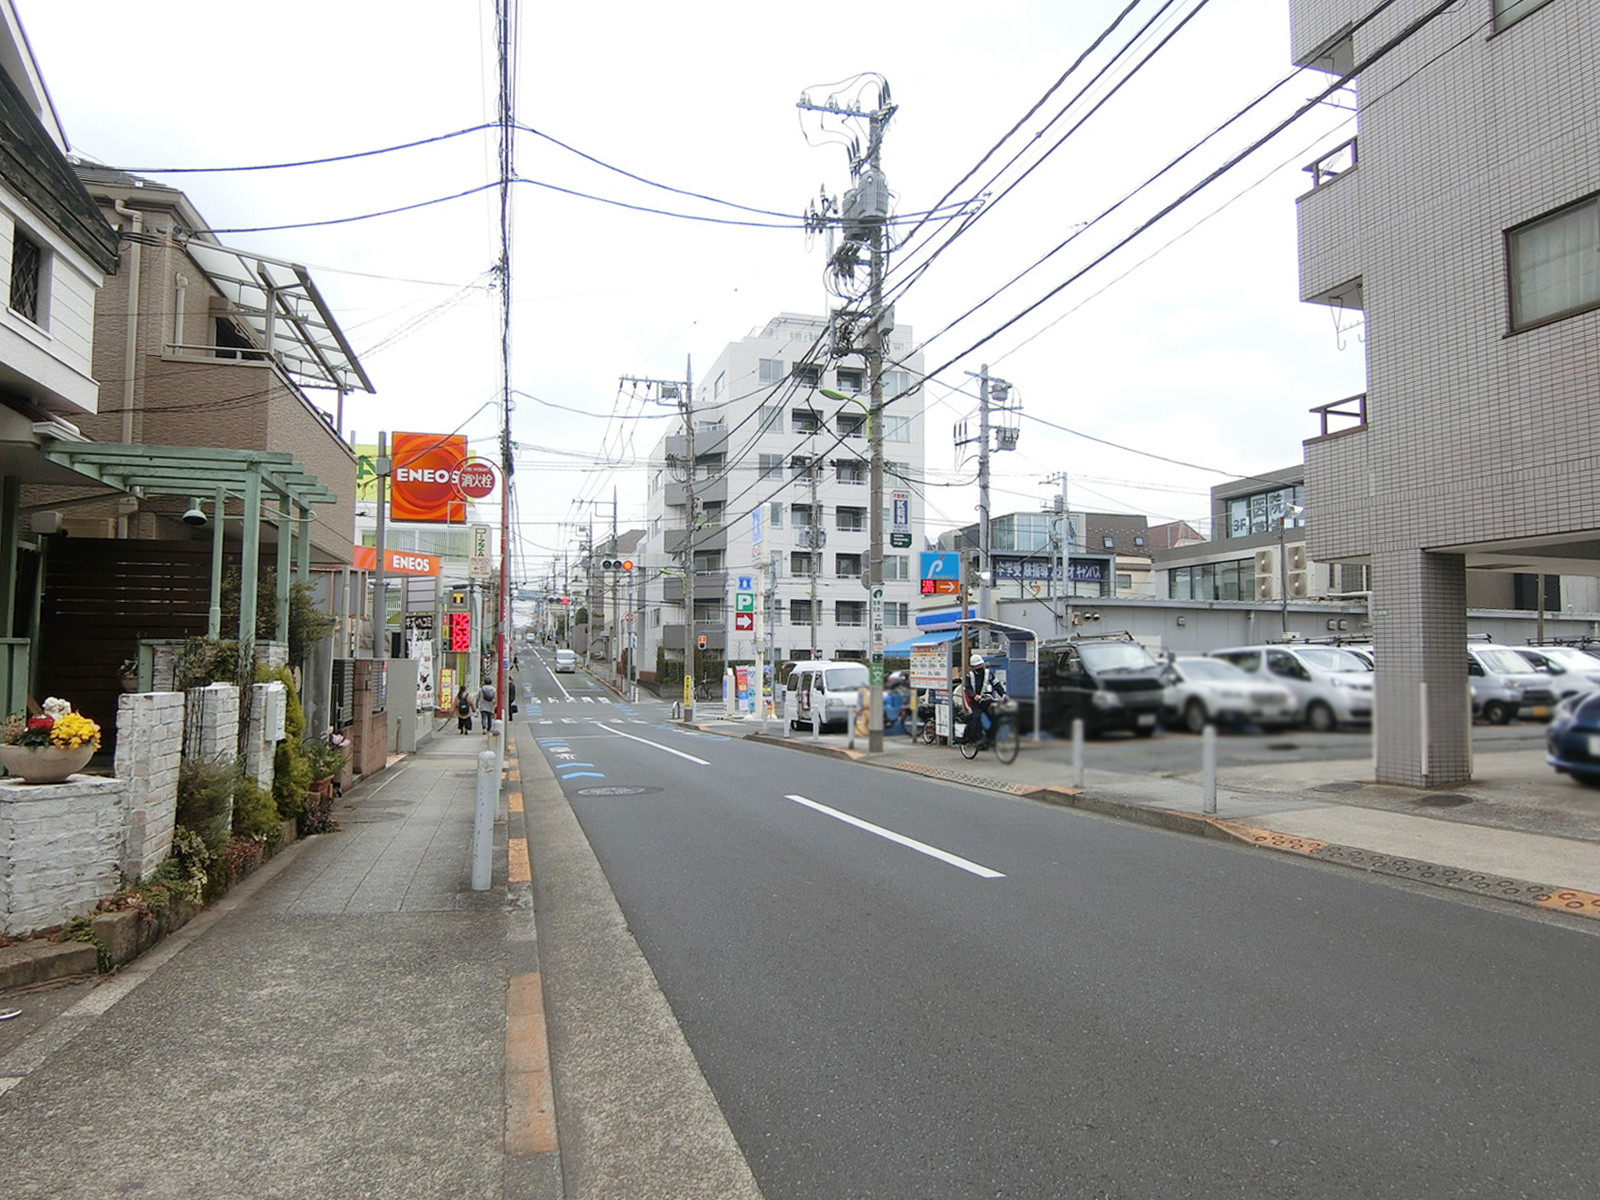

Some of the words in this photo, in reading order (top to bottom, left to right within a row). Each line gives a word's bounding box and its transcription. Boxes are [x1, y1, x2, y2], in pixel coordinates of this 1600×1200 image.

[461, 473, 493, 488] 消火栓
[896, 500, 906, 524] KEN
[1252, 493, 1284, 519] 医院
[1233, 519, 1246, 532] 3F
[475, 528, 487, 557] PIZZA
[392, 555, 430, 571] ENEOS
[922, 579, 935, 594] 満
[738, 594, 752, 610] P
